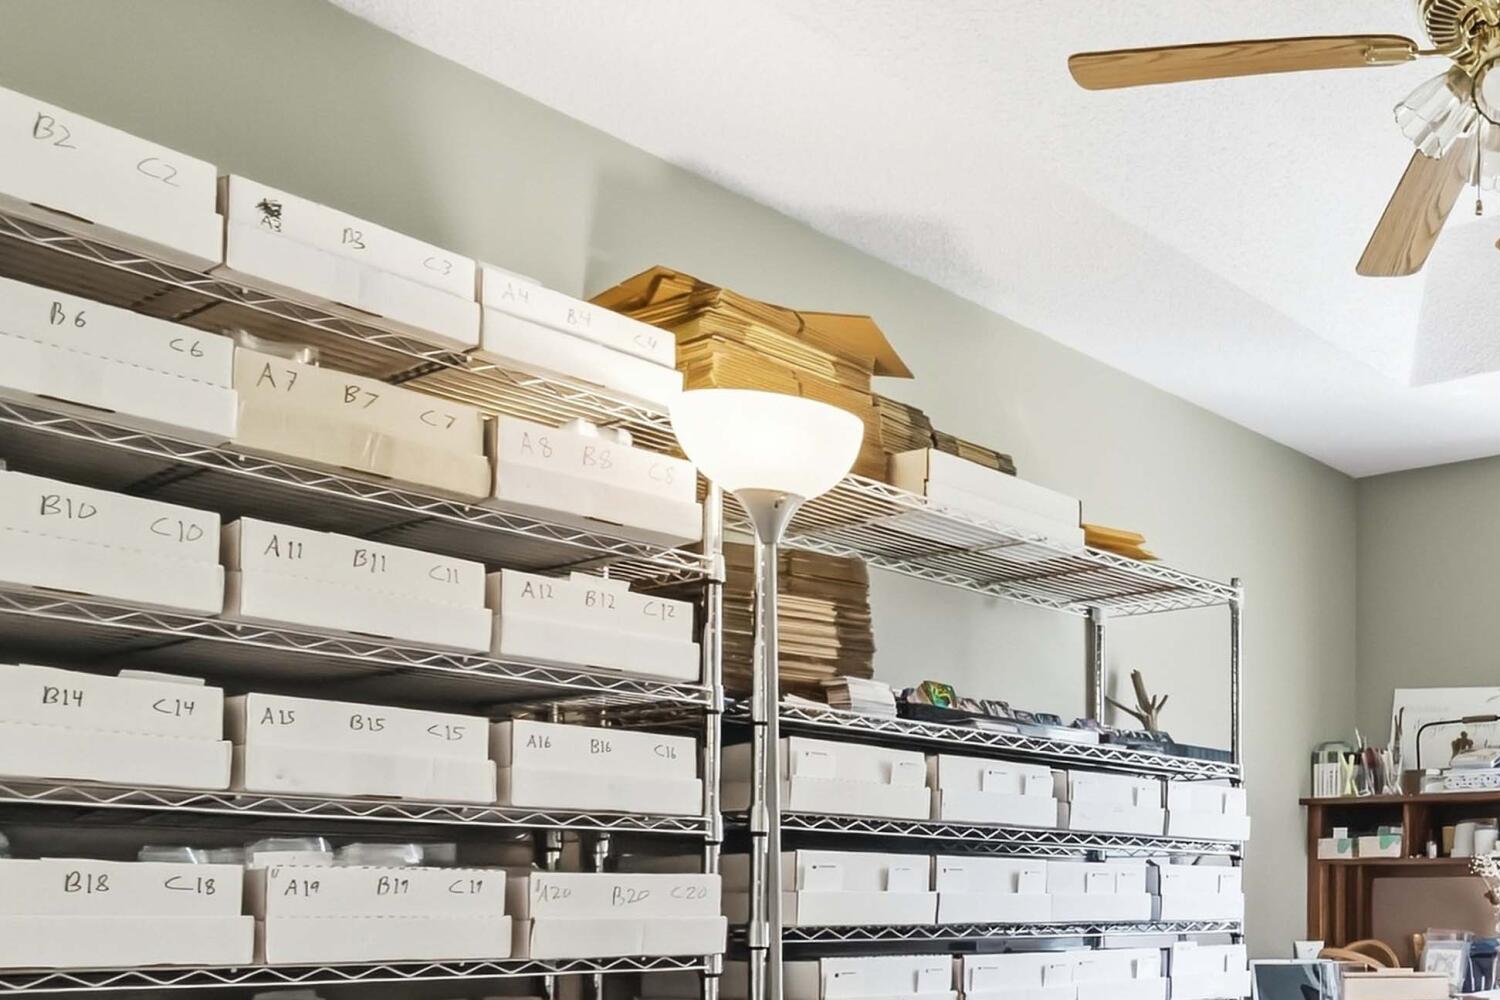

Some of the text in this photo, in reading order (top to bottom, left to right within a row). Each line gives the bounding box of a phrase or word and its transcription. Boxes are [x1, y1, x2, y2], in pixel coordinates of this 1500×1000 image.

[33, 112, 180, 187] B2 C2
[260, 214, 452, 275] A3 B3 C3
[502, 282, 529, 303] A4
[567, 308, 591, 327] B4
[50, 302, 204, 357] B6 C6
[256, 362, 456, 429] A7 B7 C7
[521, 432, 552, 458] A8
[583, 446, 613, 469] B8
[39, 495, 203, 542] B10 C10
[264, 535, 459, 584] A11 B11 C11
[521, 581, 674, 620] A12 B12 C12
[42, 686, 195, 716] B14 C14
[261, 707, 464, 741] A15 B15 C15
[527, 734, 676, 760] A16 B16 C16
[64, 871, 216, 895] B18 C18
[284, 876, 483, 897] A19 B19 C19
[537, 885, 707, 906] A20 B20 C20
